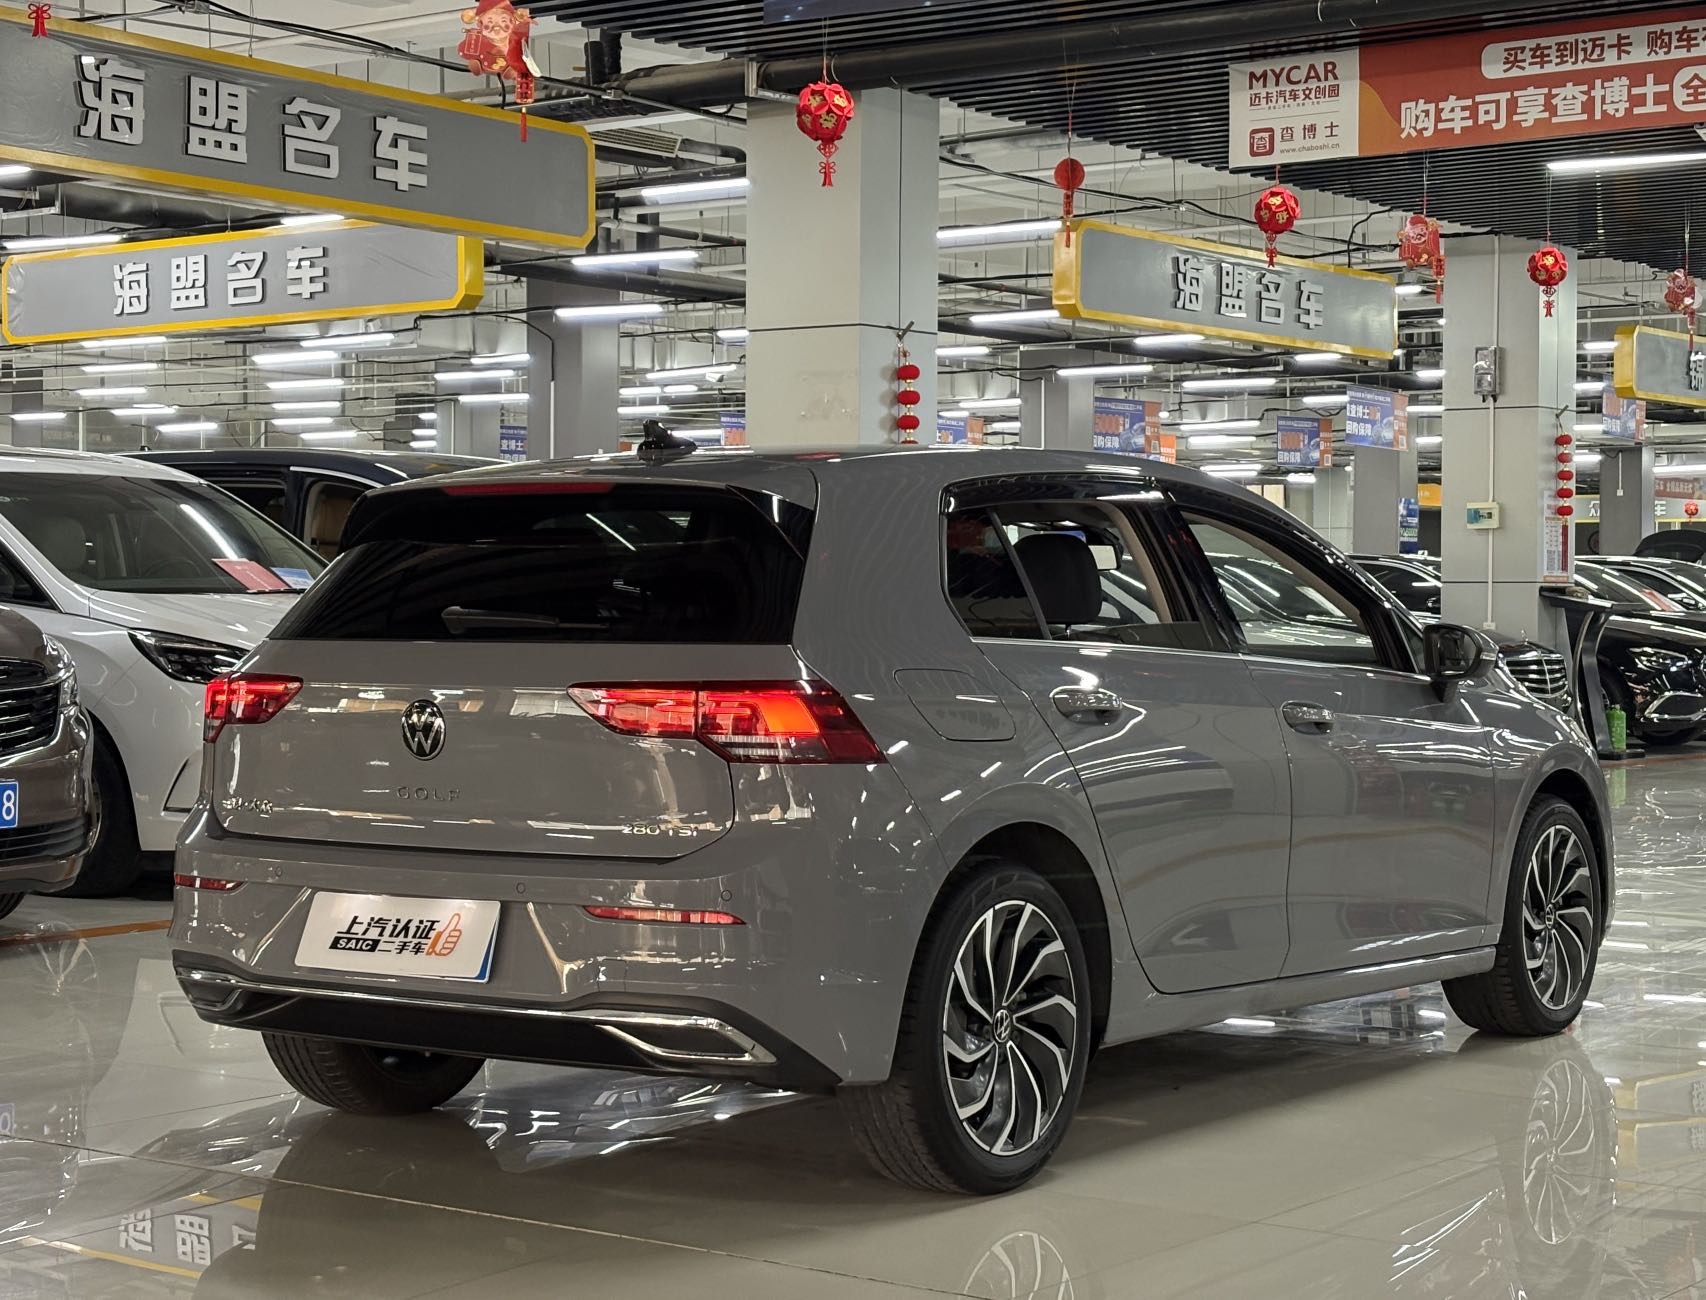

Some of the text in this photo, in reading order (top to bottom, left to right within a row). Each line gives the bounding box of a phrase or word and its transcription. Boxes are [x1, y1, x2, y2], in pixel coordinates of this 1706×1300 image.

[1502, 25, 1706, 74] 买车到迈卡 购车
[1248, 61, 1339, 90] MYCAR
[1249, 84, 1340, 107] 迈卡汽车文创园
[1399, 72, 1670, 140] 购车可享查博士
[74, 54, 429, 192] 海盟名车
[1280, 121, 1340, 143] 查博士
[112, 246, 329, 316] 海盟名车
[1171, 252, 1324, 330] 海盟名车
[397, 786, 460, 801] GOLF
[621, 822, 660, 836] 280
[336, 915, 440, 940] 上汽认证
[336, 938, 374, 951] SAIC
[377, 940, 429, 956] 二手车
